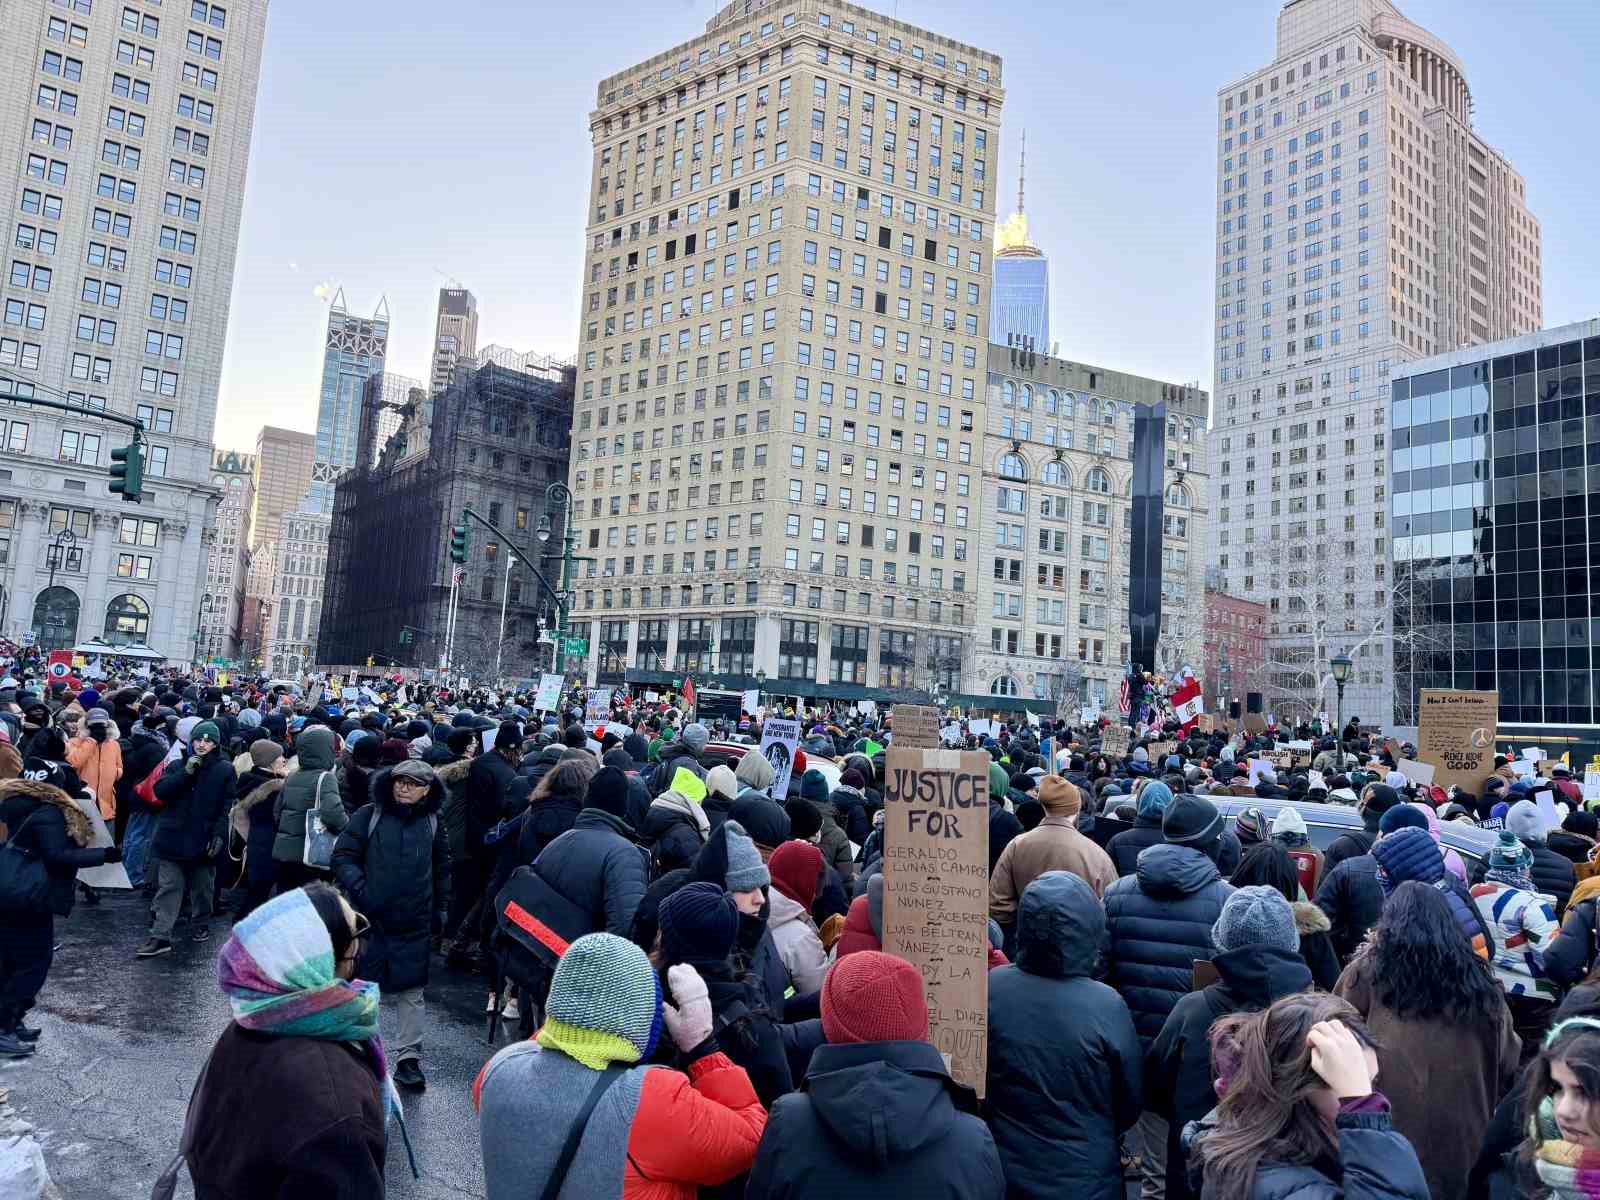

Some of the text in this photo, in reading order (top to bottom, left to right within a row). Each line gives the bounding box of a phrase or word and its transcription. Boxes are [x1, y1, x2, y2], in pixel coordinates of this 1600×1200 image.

[1446, 761, 1478, 770] GOOD
[885, 768, 988, 810] JUSTICE
[908, 809, 963, 838] FOR
[886, 847, 957, 860] GERALDO
[893, 862, 986, 878] LUNAS CAMPOS
[887, 882, 981, 898] LUIS GUSTAVO
[897, 897, 945, 911] NUNEZ
[927, 911, 986, 925] CACERES
[886, 924, 983, 944] LUIS BELTRAN
[950, 966, 972, 980] LA
[955, 1009, 985, 1026] DIAZ
